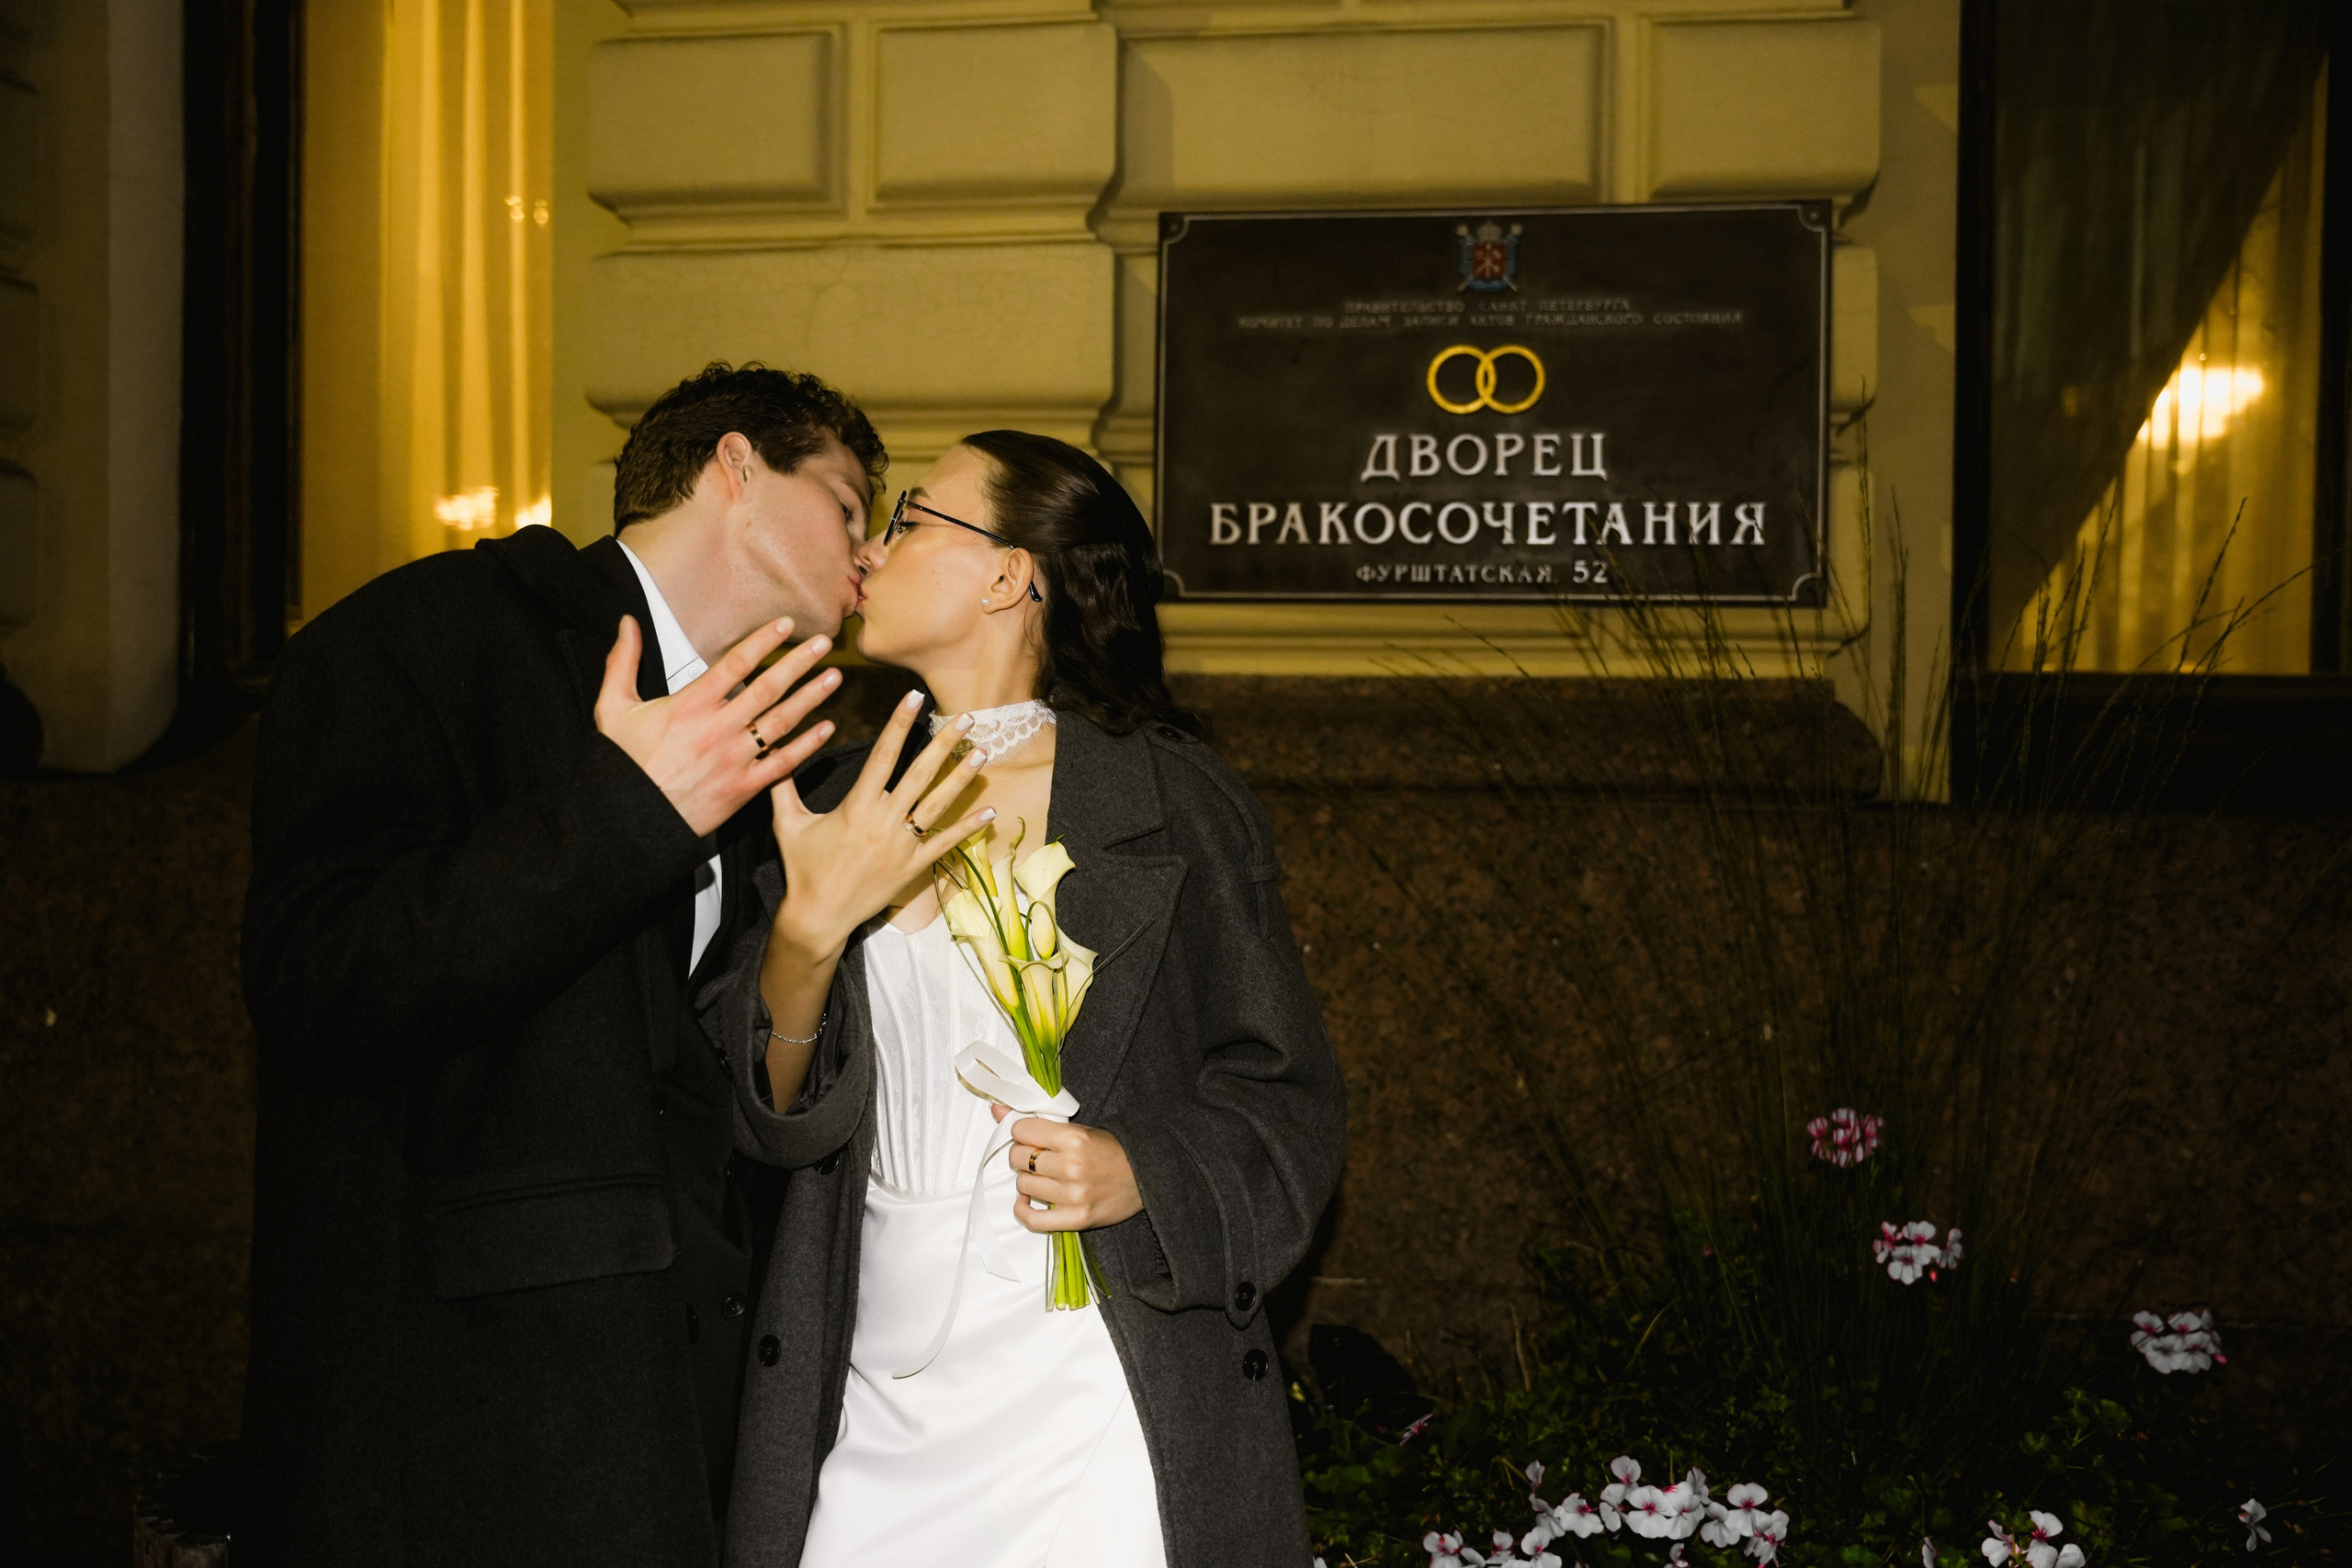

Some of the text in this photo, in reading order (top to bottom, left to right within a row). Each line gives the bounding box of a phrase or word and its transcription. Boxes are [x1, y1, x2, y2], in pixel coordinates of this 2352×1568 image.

[1361, 434, 1609, 481] ДВОРЕЦ
[1209, 502, 1767, 545] БРАКОСОЧЕТАНИЯ
[1572, 560, 1610, 583] 52
